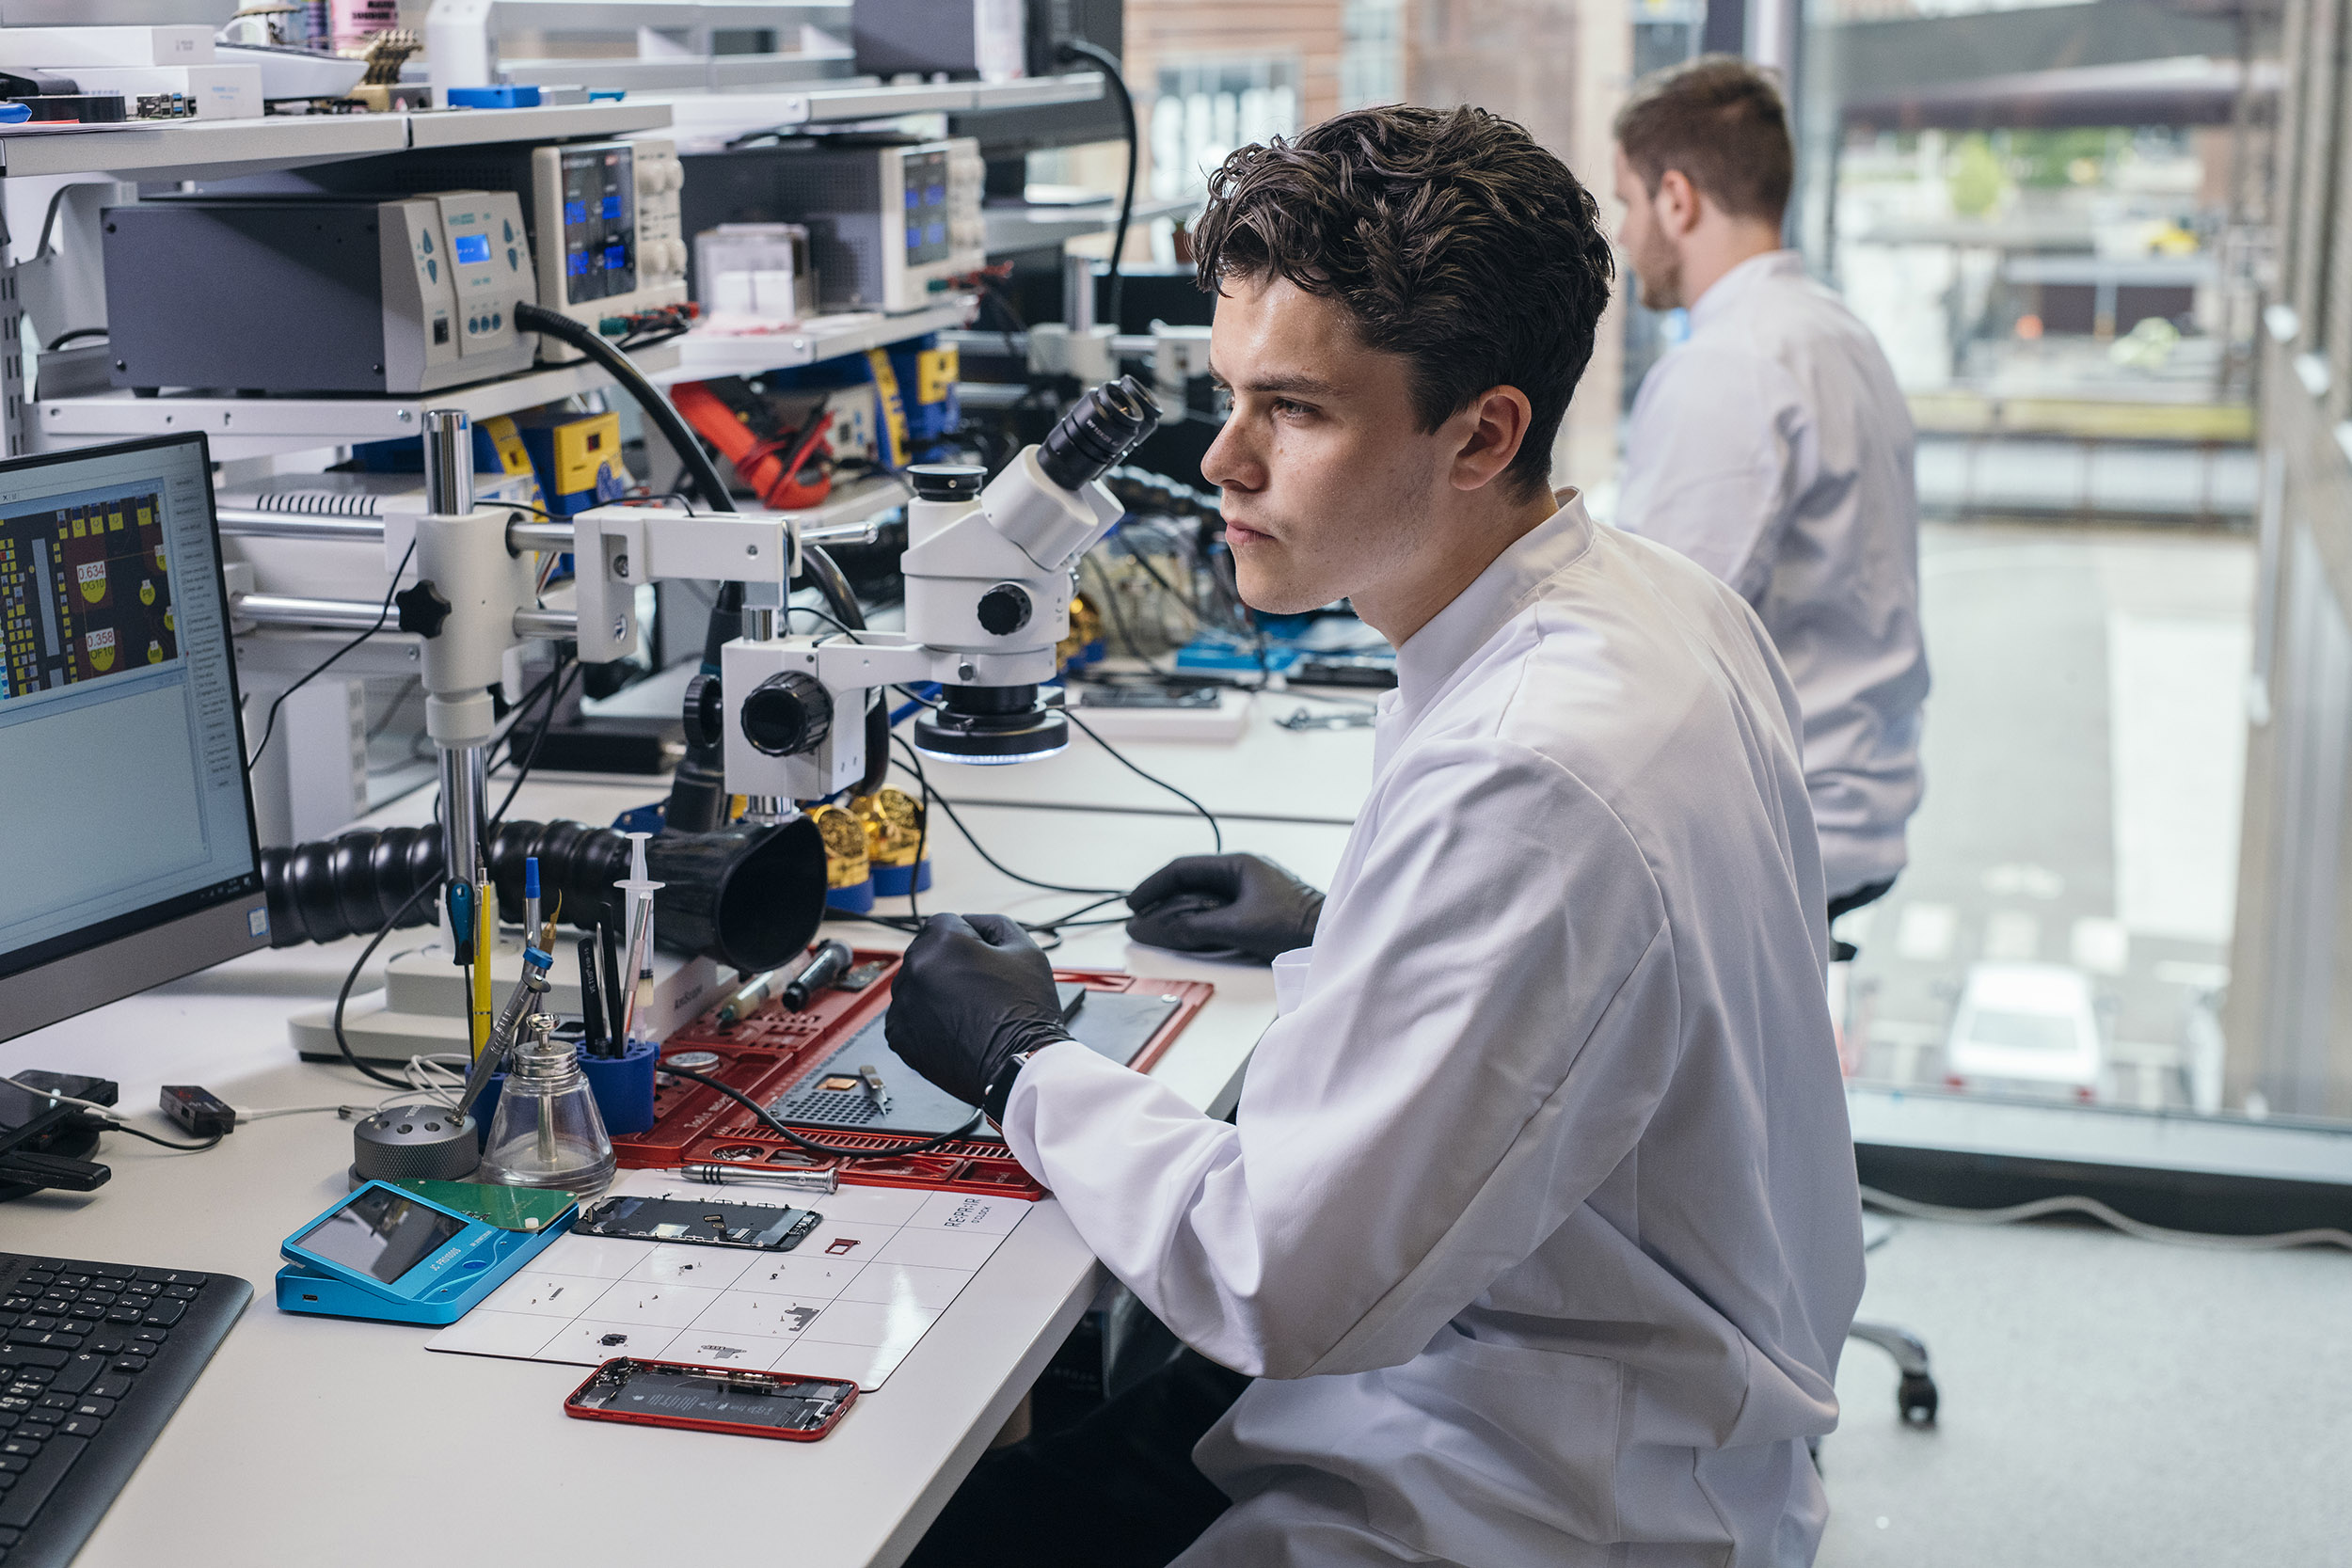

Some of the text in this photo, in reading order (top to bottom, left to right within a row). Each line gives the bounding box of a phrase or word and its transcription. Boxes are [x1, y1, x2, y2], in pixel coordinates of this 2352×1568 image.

[78, 564, 105, 580] 0.634
[87, 630, 114, 648] 0.358
[89, 646, 114, 659] OF10
